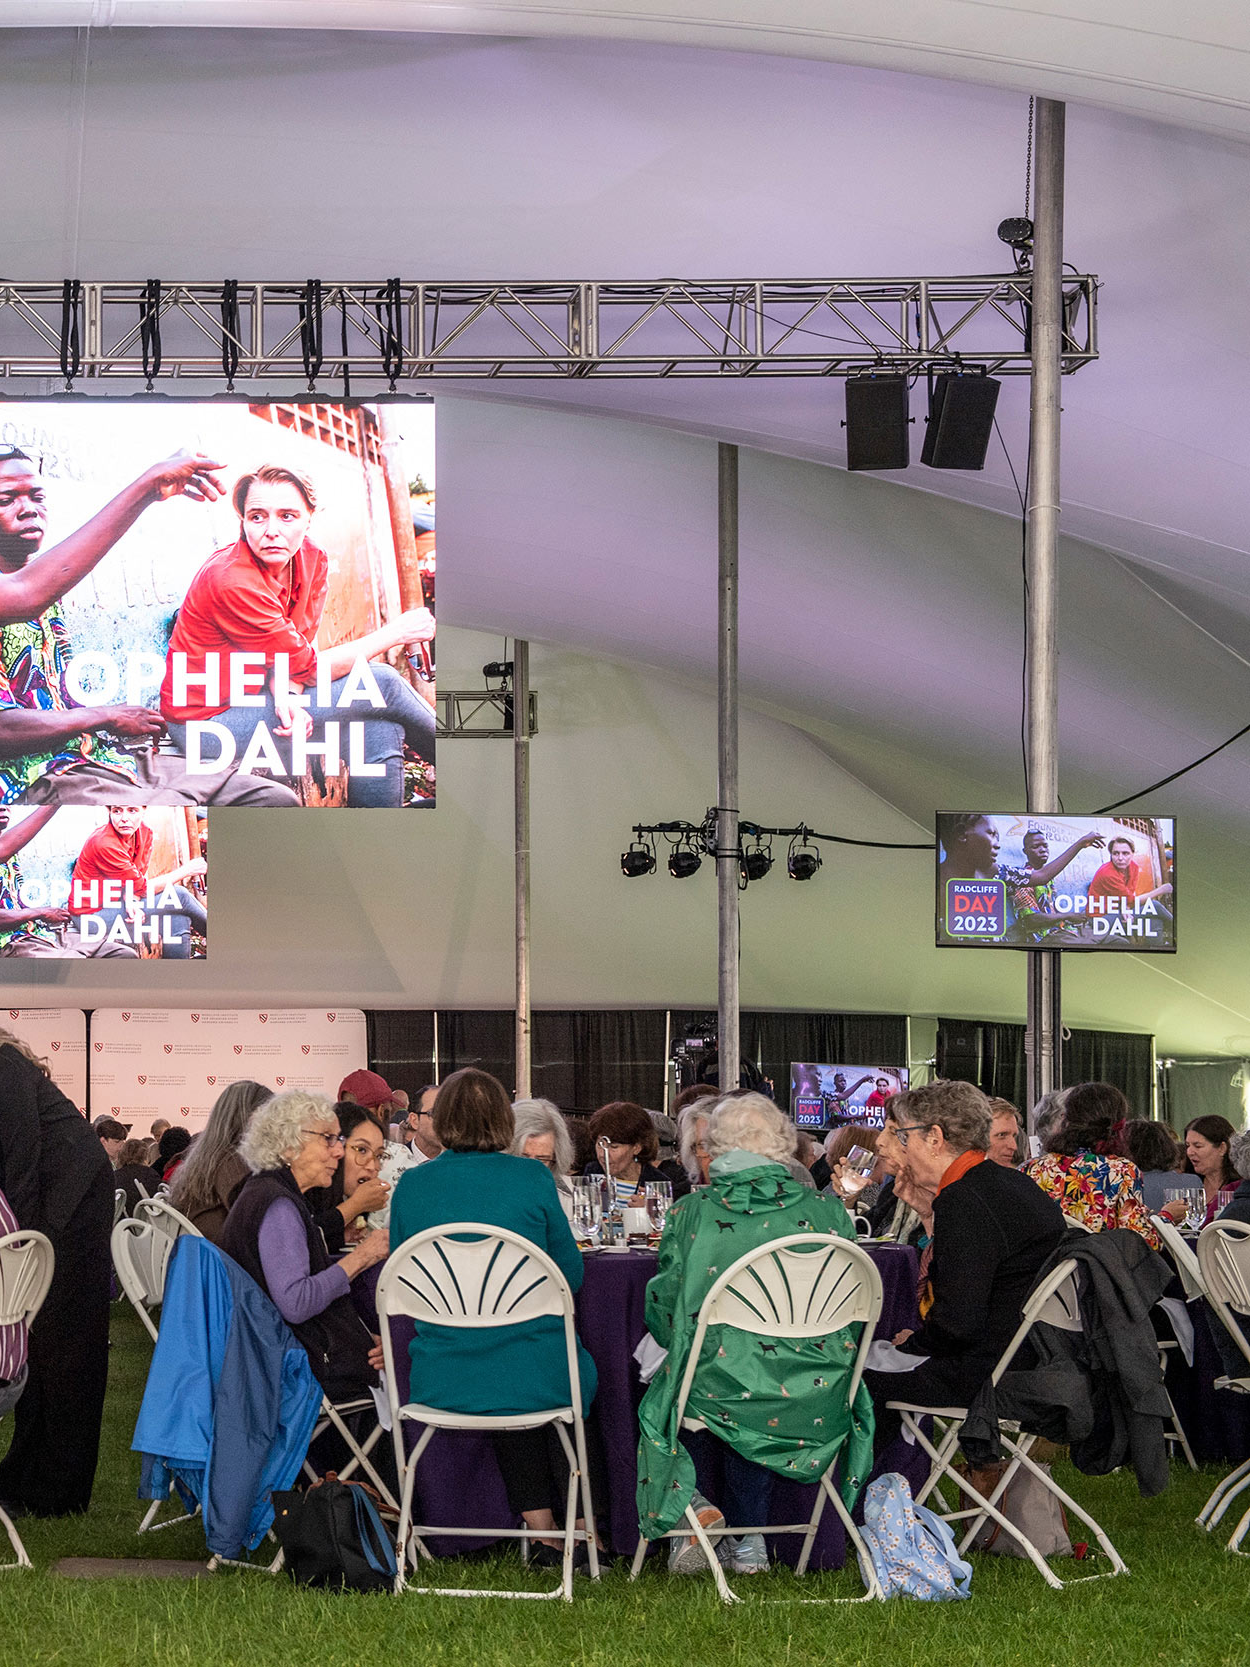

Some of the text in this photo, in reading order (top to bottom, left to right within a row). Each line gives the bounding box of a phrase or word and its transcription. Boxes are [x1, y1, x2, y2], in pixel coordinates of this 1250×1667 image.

[65, 651, 387, 709] OPHELIA
[185, 720, 387, 778] DAHL
[20, 879, 183, 910] OPHELIA
[954, 885, 998, 894] RADCLIFFE
[954, 895, 998, 913] DAY
[1054, 894, 1158, 916] OPHELIA
[80, 914, 183, 944] DAHL
[953, 915, 998, 933] 2023
[1093, 917, 1158, 937] DAHL
[798, 1104, 821, 1114] DAY
[798, 1115, 821, 1124] 2023
